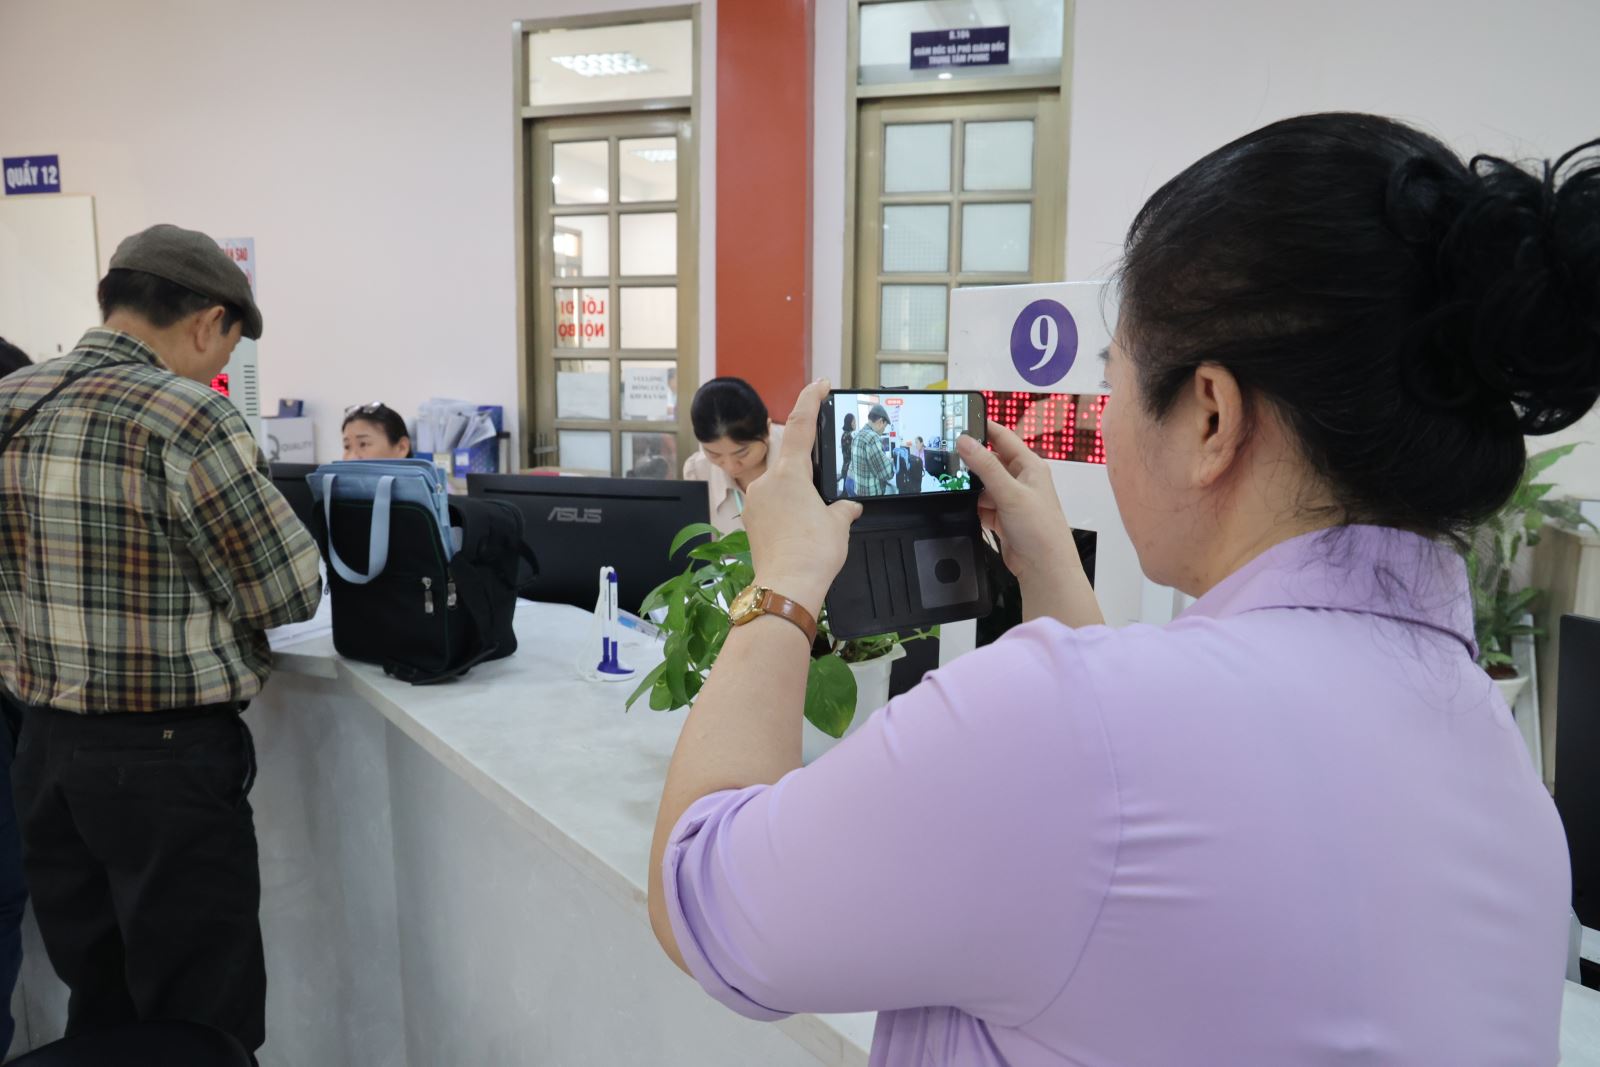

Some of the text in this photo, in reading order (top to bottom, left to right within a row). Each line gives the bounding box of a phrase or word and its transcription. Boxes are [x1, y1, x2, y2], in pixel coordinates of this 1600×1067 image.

[40, 165, 58, 185] 12
[1029, 314, 1059, 372] 9
[547, 506, 602, 523] ASUS
